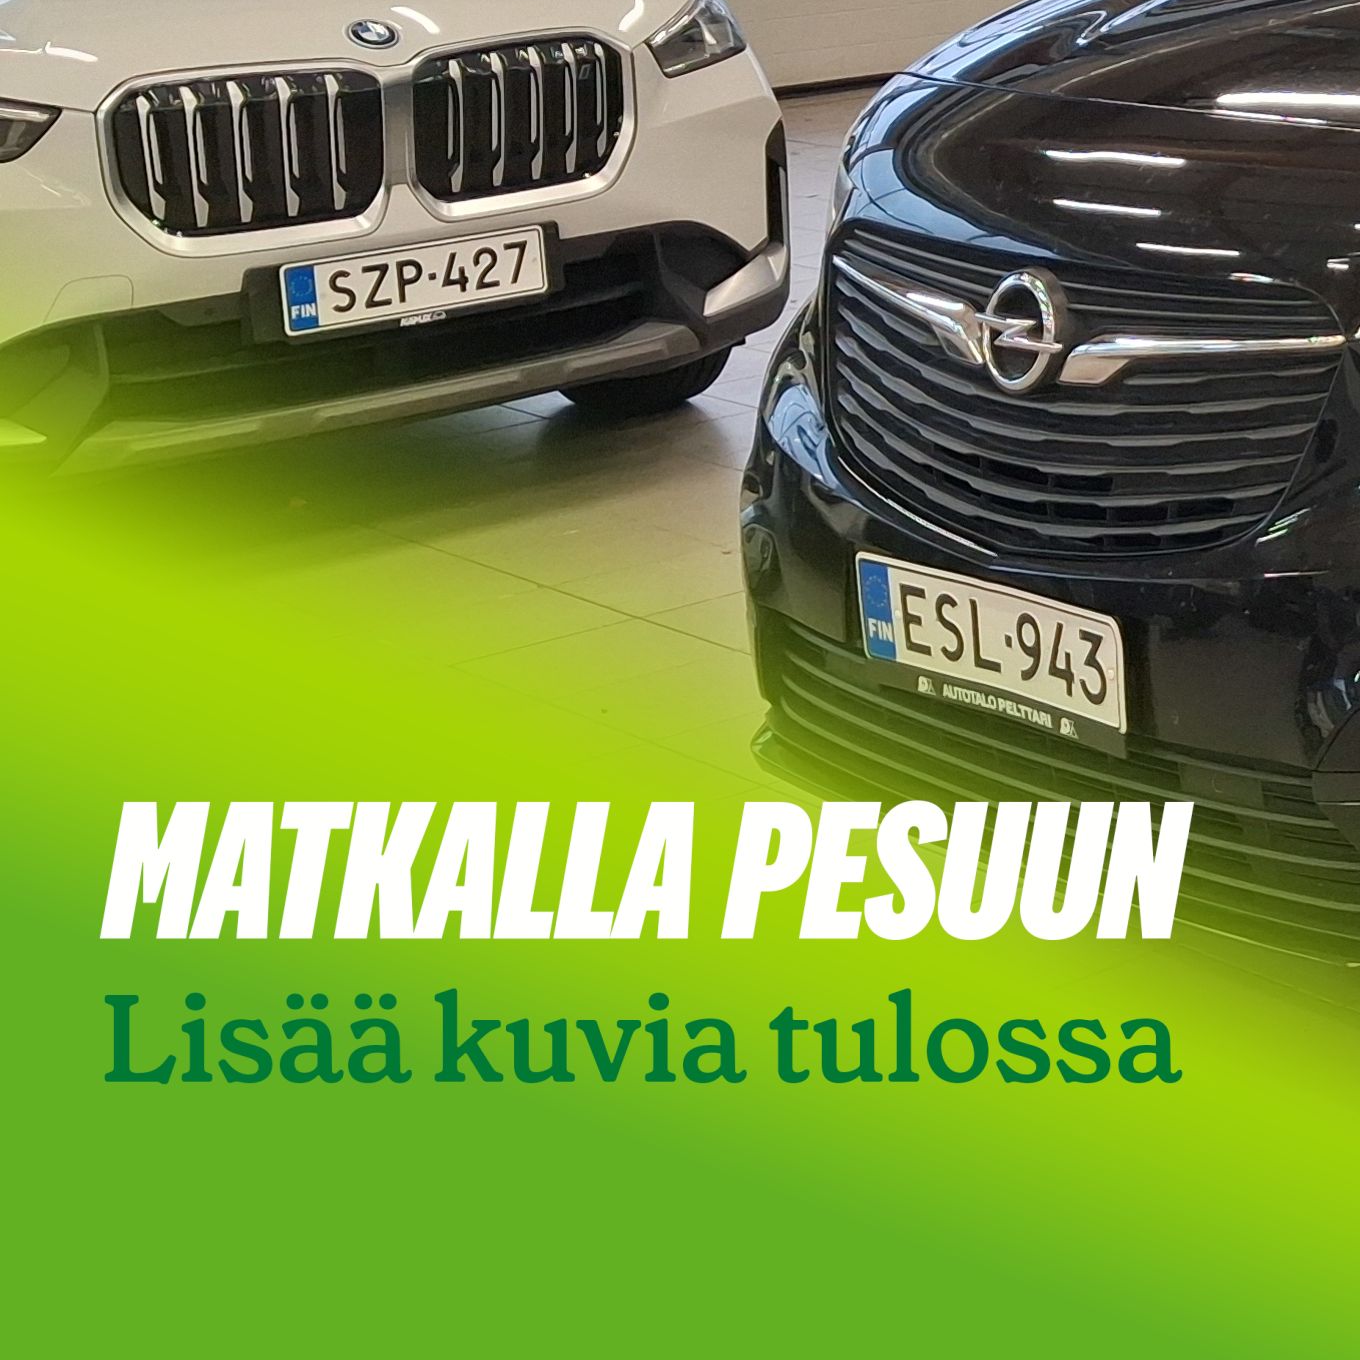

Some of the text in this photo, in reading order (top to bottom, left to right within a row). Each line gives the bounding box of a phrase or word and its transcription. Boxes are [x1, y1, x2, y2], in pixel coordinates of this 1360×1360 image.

[291, 240, 528, 321] FIN SZP-427
[868, 583, 1108, 706] FIN ESL-943
[942, 683, 998, 710] AUTOTALO
[998, 697, 1053, 729] PELTTARI
